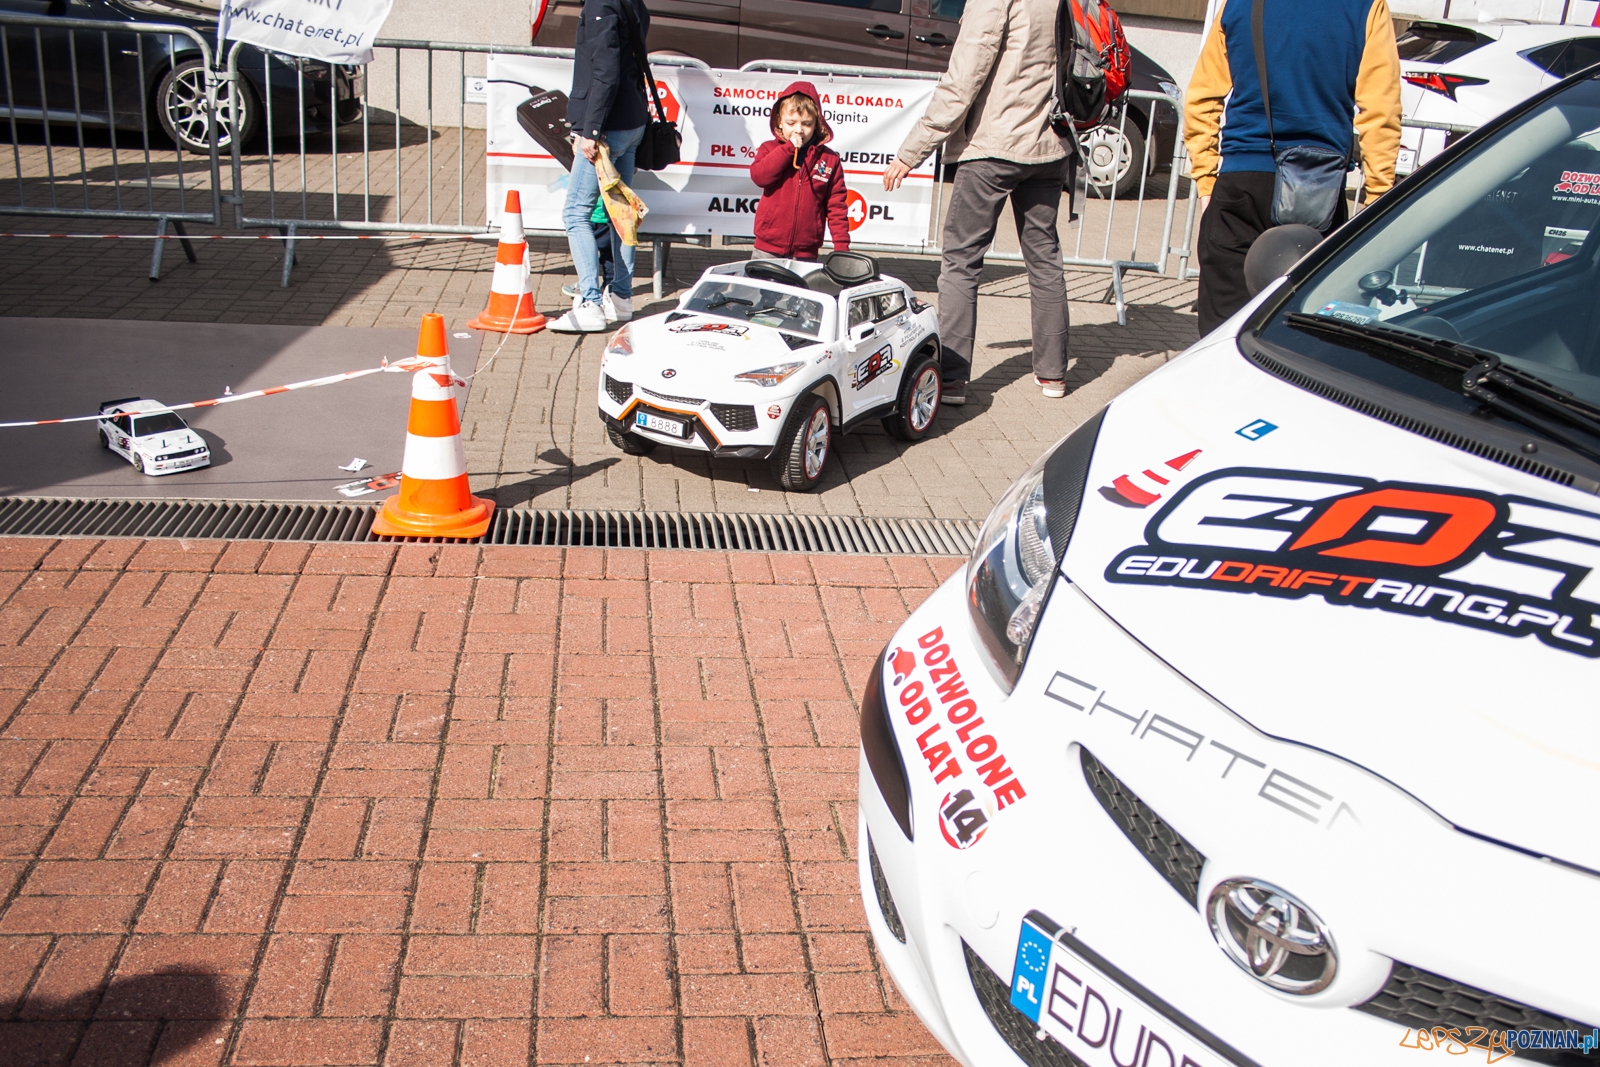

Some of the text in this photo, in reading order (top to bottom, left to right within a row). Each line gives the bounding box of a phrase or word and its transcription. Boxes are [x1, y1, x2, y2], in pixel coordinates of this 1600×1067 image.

[713, 86, 903, 108] SAMOCHA BLOKADA
[823, 110, 868, 124] Dignita
[711, 144, 736, 157] PIŁ
[1572, 183, 1590, 194] OD
[1548, 229, 1567, 237] CH26
[1458, 243, 1514, 255] www.chatenet.pl
[651, 417, 678, 434] 8888
[1116, 555, 1594, 646] EDUDRIFTRING.PL
[917, 626, 1027, 811] DOZWOLONE
[899, 681, 963, 786] OD LAT
[943, 788, 988, 845] 14
[1016, 974, 1038, 1004] PL
[1047, 962, 1202, 1067] EDUD
